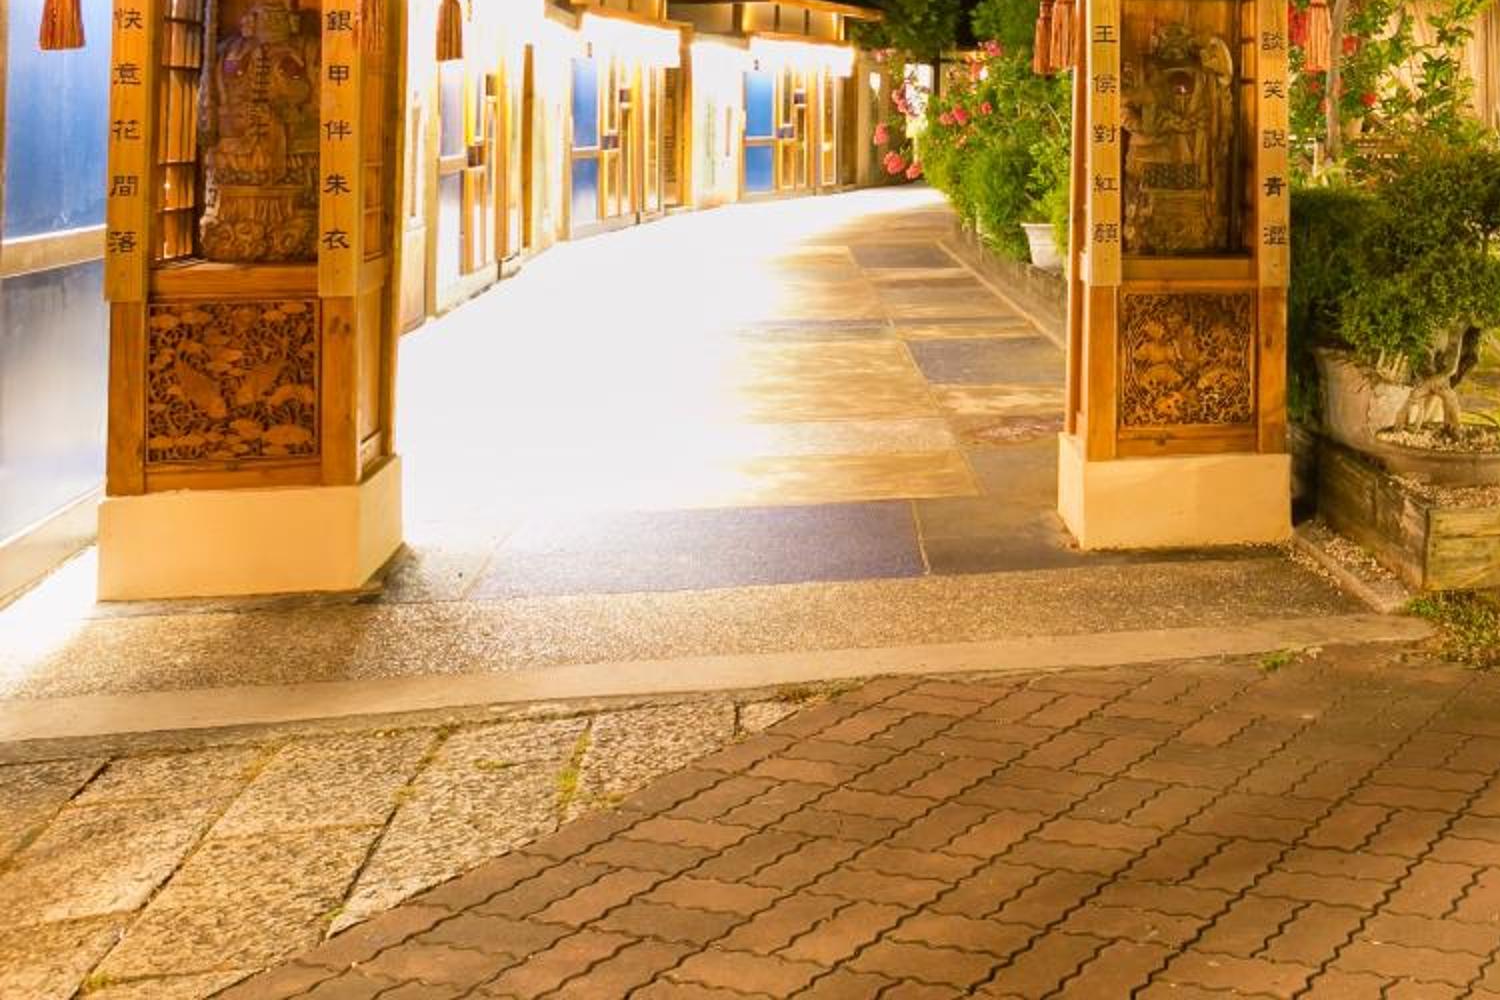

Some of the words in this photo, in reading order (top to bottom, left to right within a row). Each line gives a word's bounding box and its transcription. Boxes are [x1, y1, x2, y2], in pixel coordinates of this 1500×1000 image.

[110, 8, 143, 254] 快意花間落
[322, 10, 353, 250] 銀甲伴朱衣
